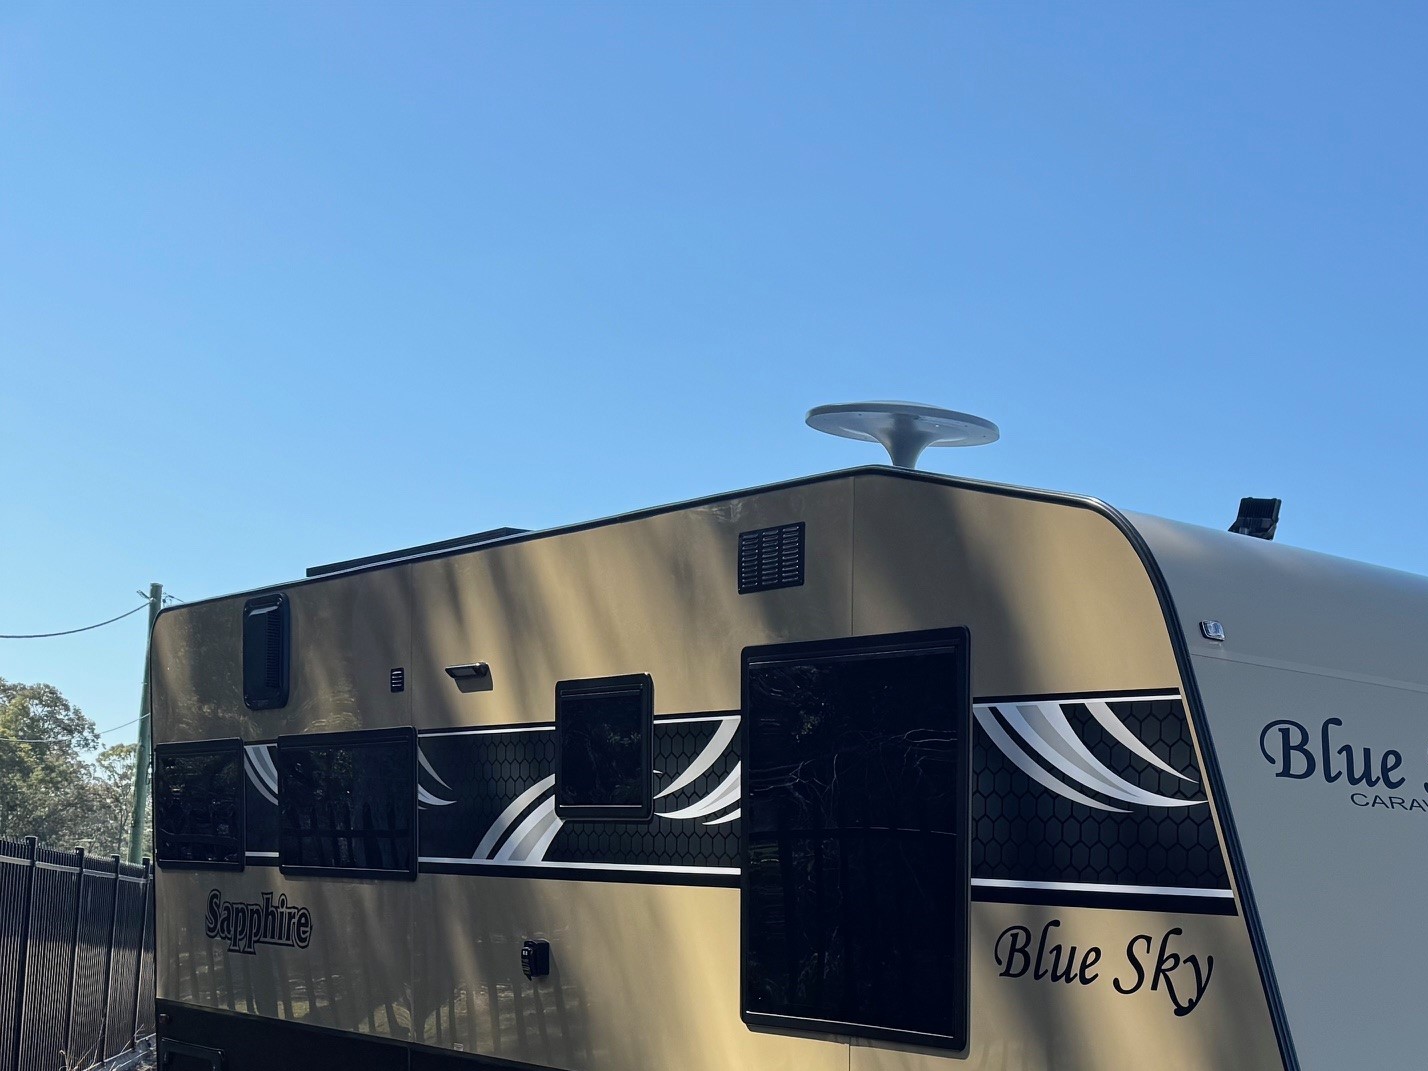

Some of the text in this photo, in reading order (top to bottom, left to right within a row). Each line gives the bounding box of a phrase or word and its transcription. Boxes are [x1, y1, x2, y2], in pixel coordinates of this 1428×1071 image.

[1258, 717, 1406, 788] Blue
[205, 888, 313, 956] Sapphire
[994, 919, 1215, 1018] Blue Sky
